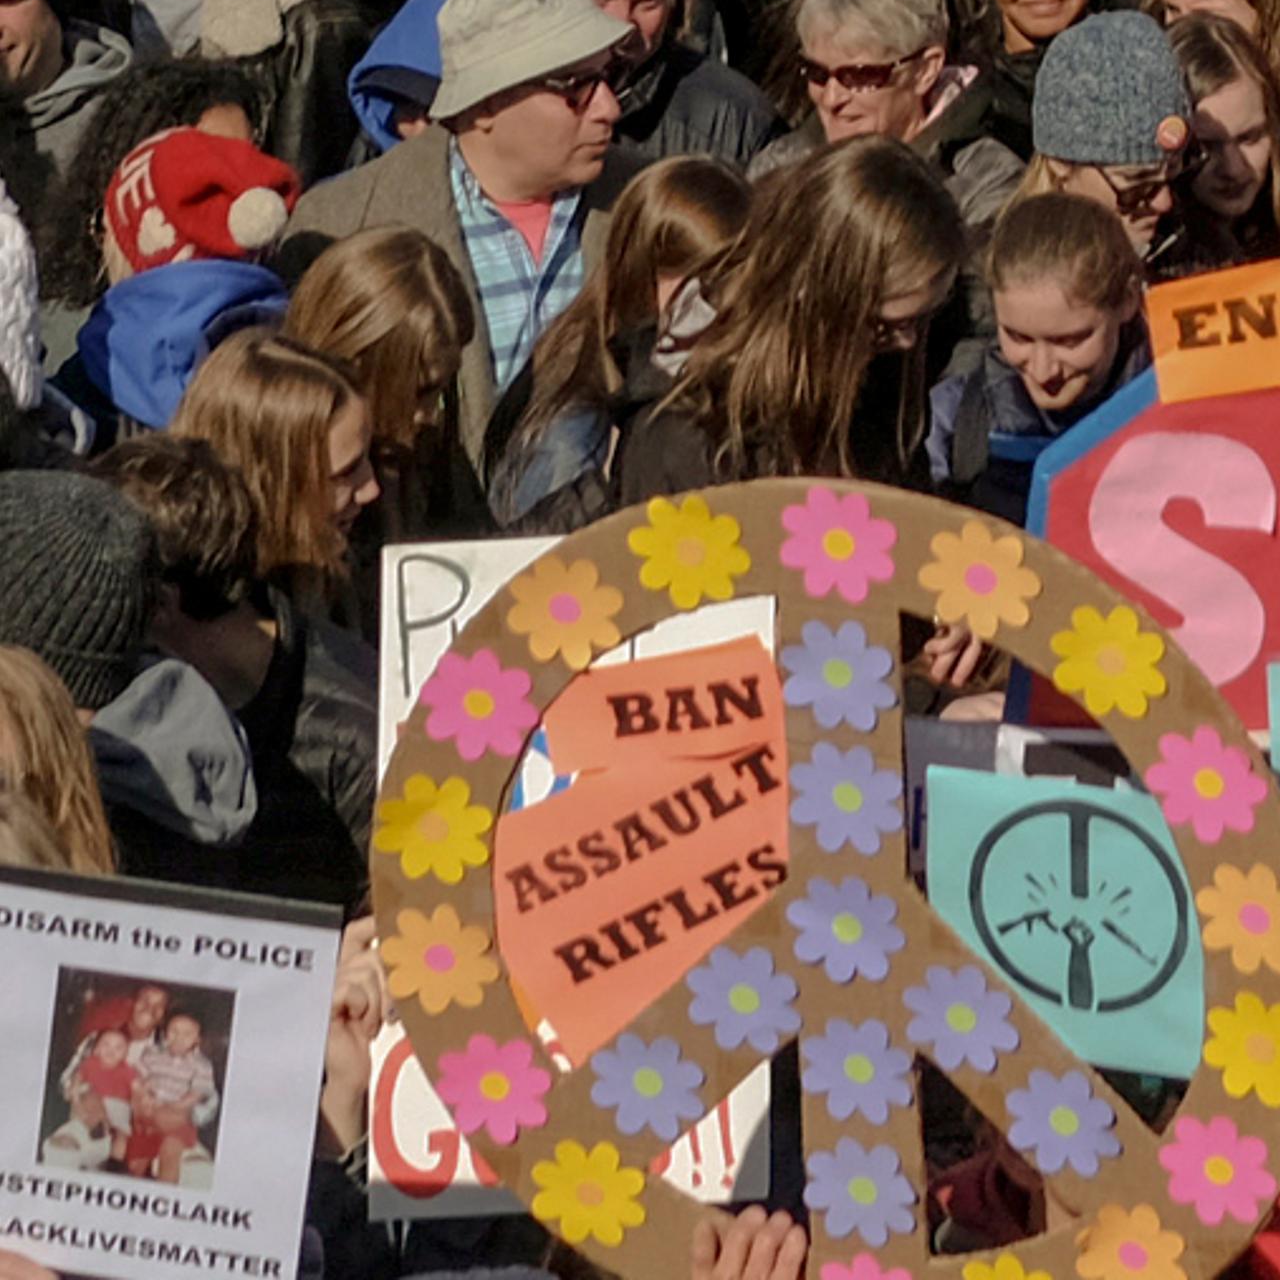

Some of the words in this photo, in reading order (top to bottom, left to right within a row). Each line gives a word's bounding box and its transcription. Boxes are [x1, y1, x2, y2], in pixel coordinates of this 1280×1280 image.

[607, 677, 765, 738] BAN
[506, 743, 784, 914] ASSAULT
[132, 929, 181, 953] the
[193, 936, 315, 971] POLICE
[554, 843, 789, 985] RIFLES
